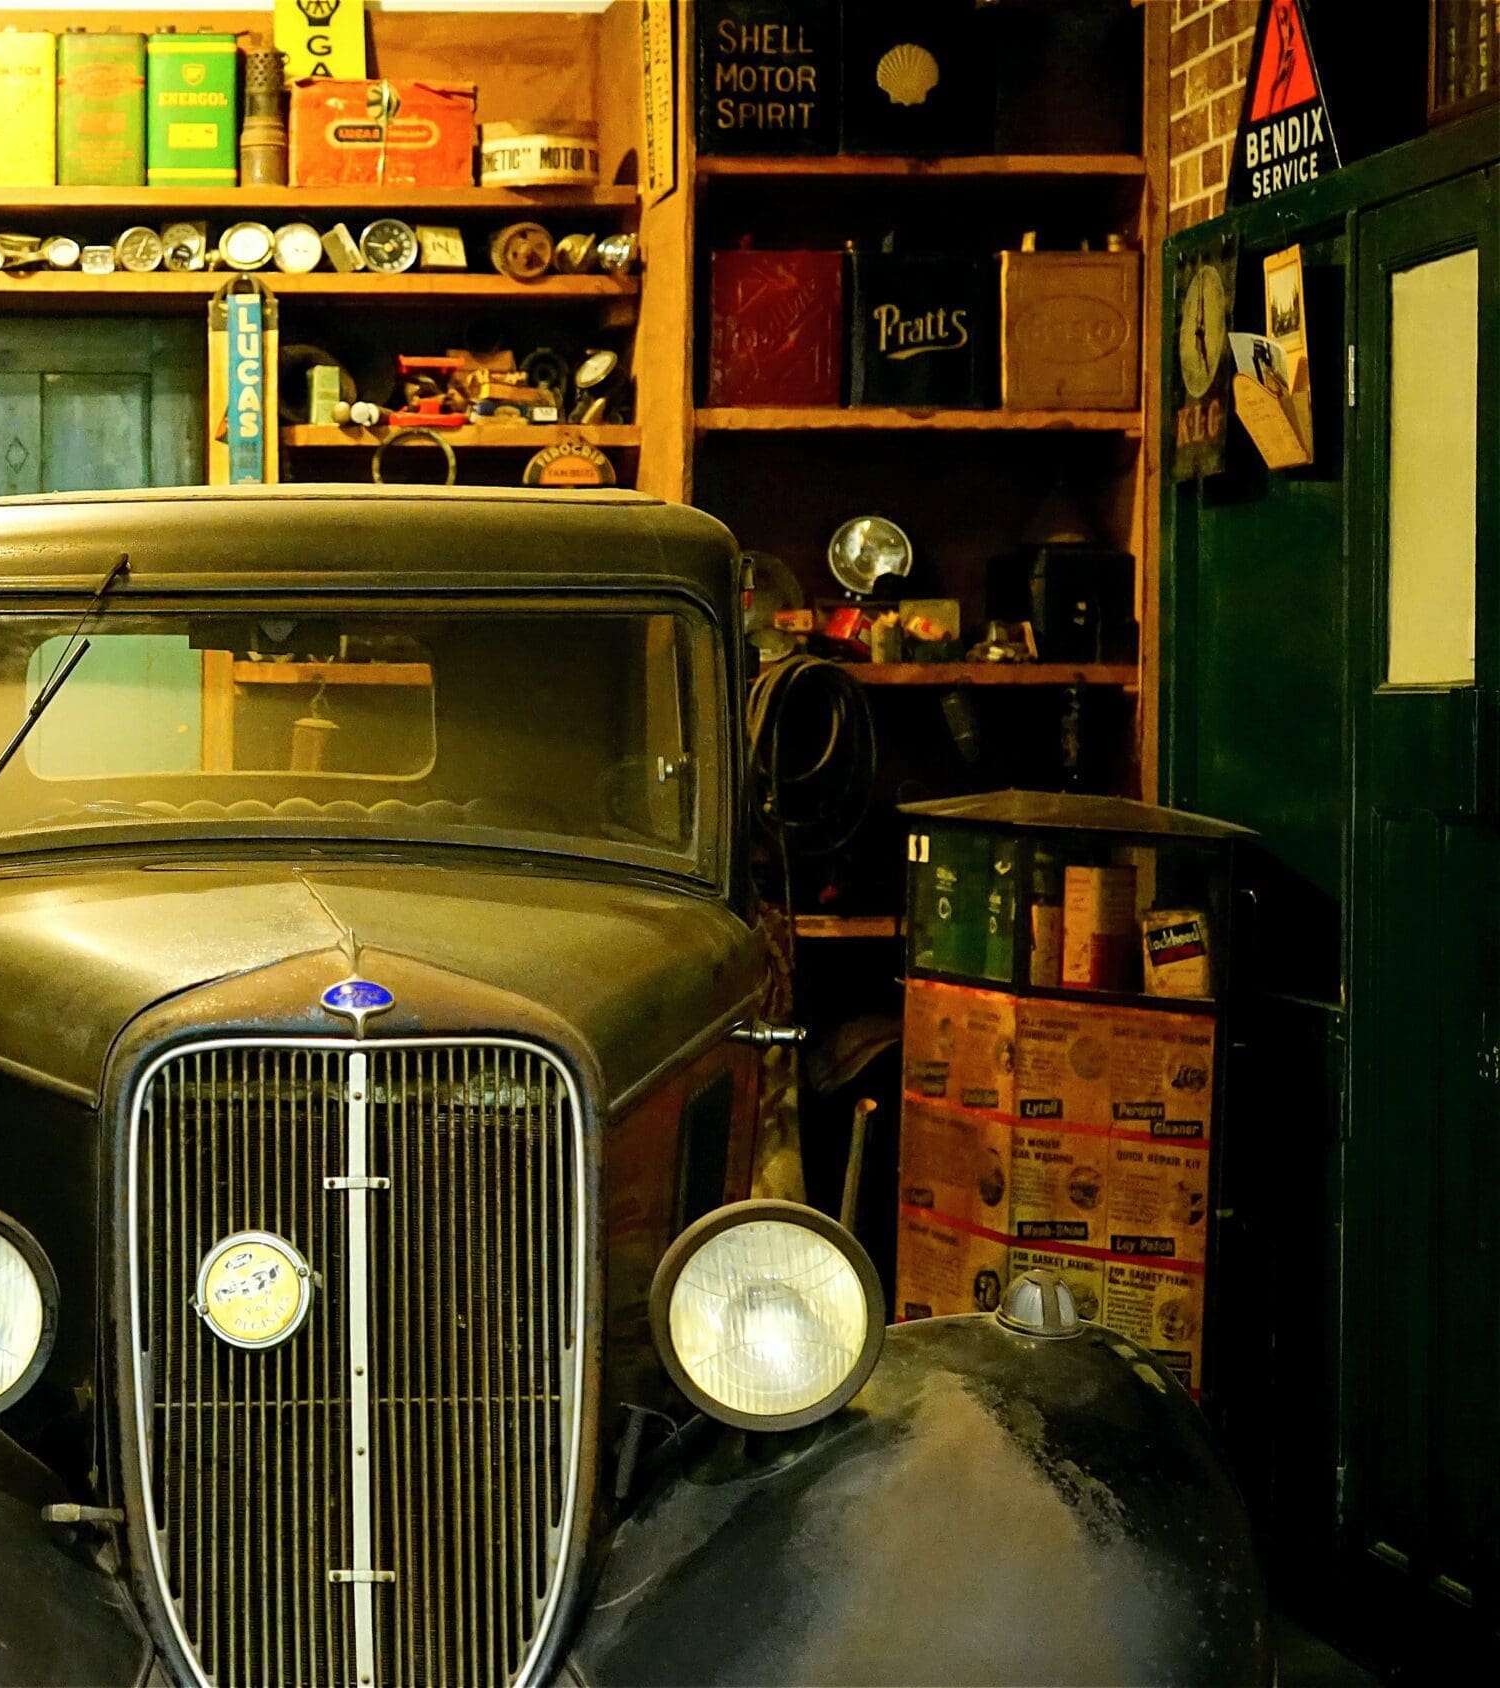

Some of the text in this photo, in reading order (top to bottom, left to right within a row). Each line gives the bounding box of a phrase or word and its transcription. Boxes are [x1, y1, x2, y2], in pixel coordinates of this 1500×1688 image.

[718, 20, 814, 54] SHELL
[715, 61, 818, 94] MOTOR
[158, 92, 228, 106] ENERGOL
[717, 100, 816, 130] SPIRIT
[1245, 105, 1325, 168] BENDIX
[1252, 151, 1319, 199] SERVICE
[873, 303, 968, 358] Pratts
[236, 306, 261, 438] LUCAS
[1185, 1158, 1202, 1169] KIT
